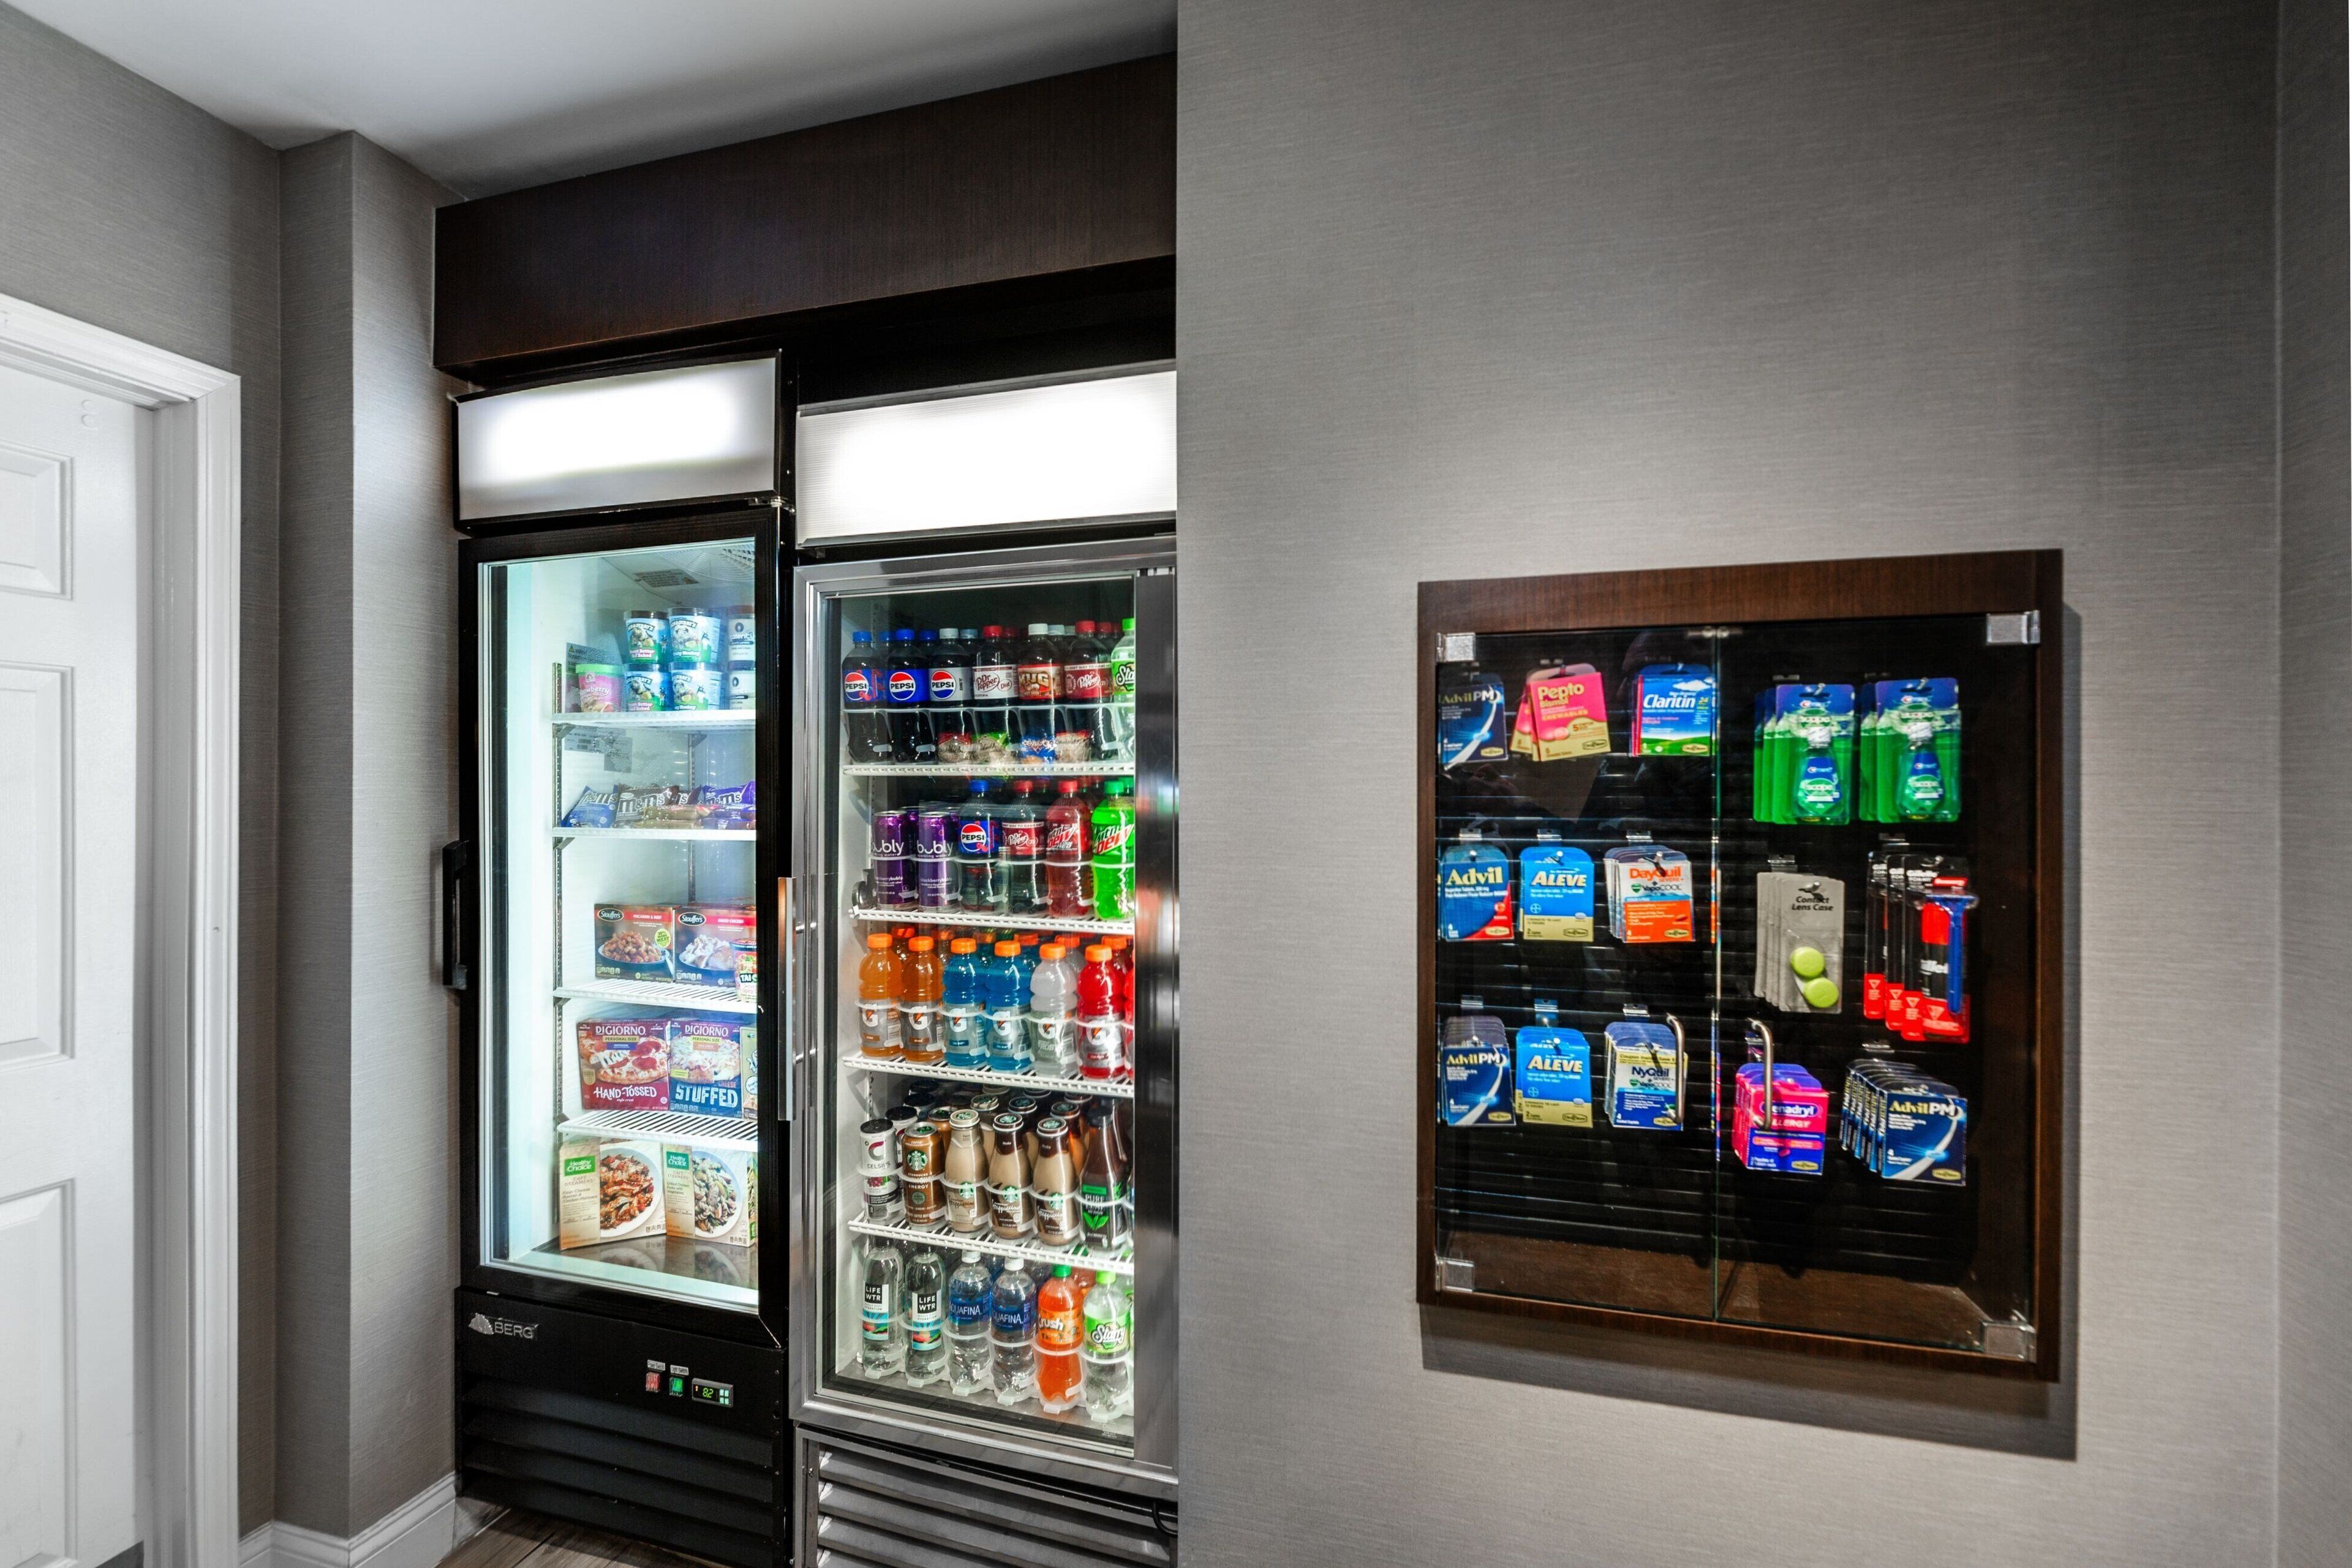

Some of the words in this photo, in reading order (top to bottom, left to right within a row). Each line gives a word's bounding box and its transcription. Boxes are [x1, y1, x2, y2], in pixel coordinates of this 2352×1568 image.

[1019, 673, 1049, 687] MUG
[1442, 692, 1472, 703] Advil
[1473, 690, 1495, 701] PM
[1537, 682, 1585, 701] Pepto
[1643, 694, 1696, 708] Claritin
[917, 839, 954, 856] bubly
[1446, 866, 1504, 886] Advil
[1531, 870, 1588, 887] ALEVE
[600, 910, 621, 919] Stouffer's
[682, 914, 704, 924] Stouffer's
[1446, 1054, 1478, 1065] Advil
[1478, 1052, 1501, 1065] PM
[1527, 1055, 1584, 1074] ALEVE
[1632, 1066, 1669, 1078] NyQuil
[593, 1085, 657, 1100] HAND-TOSSED
[674, 1083, 739, 1108] STUFFED
[1771, 1104, 1814, 1117] enadryl
[1888, 1100, 1929, 1114] Advil
[1928, 1102, 1956, 1116] PM
[567, 1164, 592, 1172] Choice
[919, 1295, 936, 1303] LIFE
[494, 1322, 533, 1338] BERG
